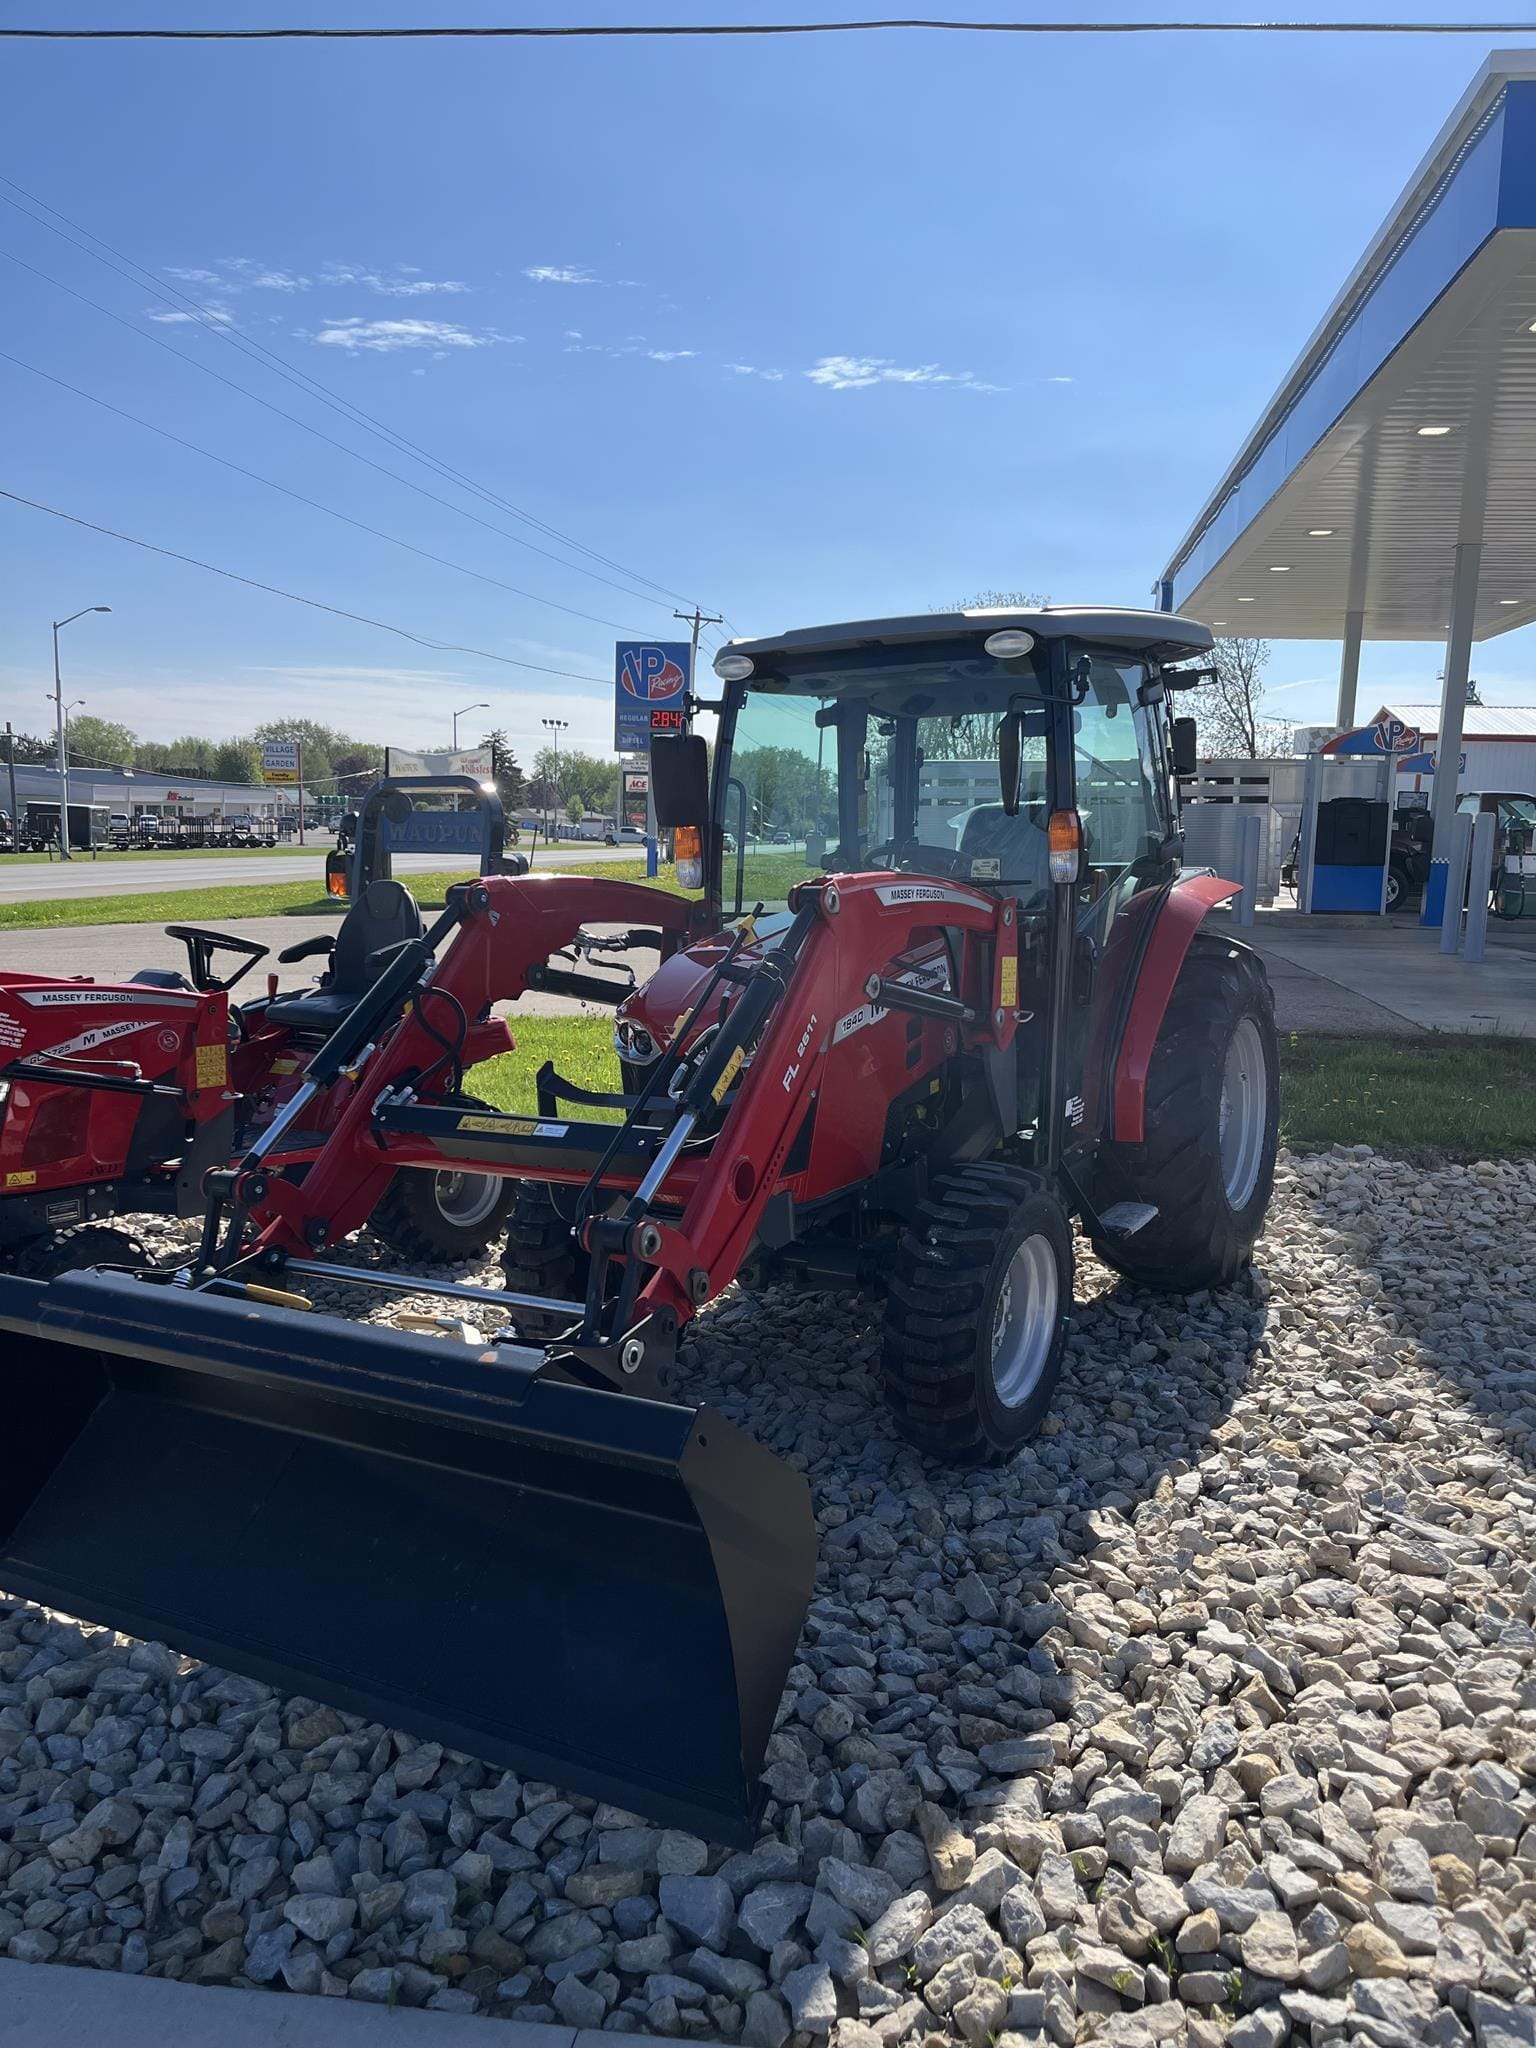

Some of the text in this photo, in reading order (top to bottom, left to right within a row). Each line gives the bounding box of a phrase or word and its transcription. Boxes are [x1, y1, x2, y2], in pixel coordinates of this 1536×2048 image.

[623, 647, 666, 699] VP
[650, 675, 683, 692] Racing
[620, 714, 648, 722] REGULAR
[1378, 720, 1407, 751] VP
[265, 745, 295, 753] VILLAGE
[630, 780, 647, 788] ACE
[390, 824, 480, 842] WAUPUN
[891, 889, 945, 900] MASSEY FERGUSON
[42, 993, 133, 1002] MASSEY FERGUSON
[841, 1010, 864, 1032] 1840
[29, 1022, 136, 1065] GC725 M MASSEY
[782, 1063, 800, 1093] FL
